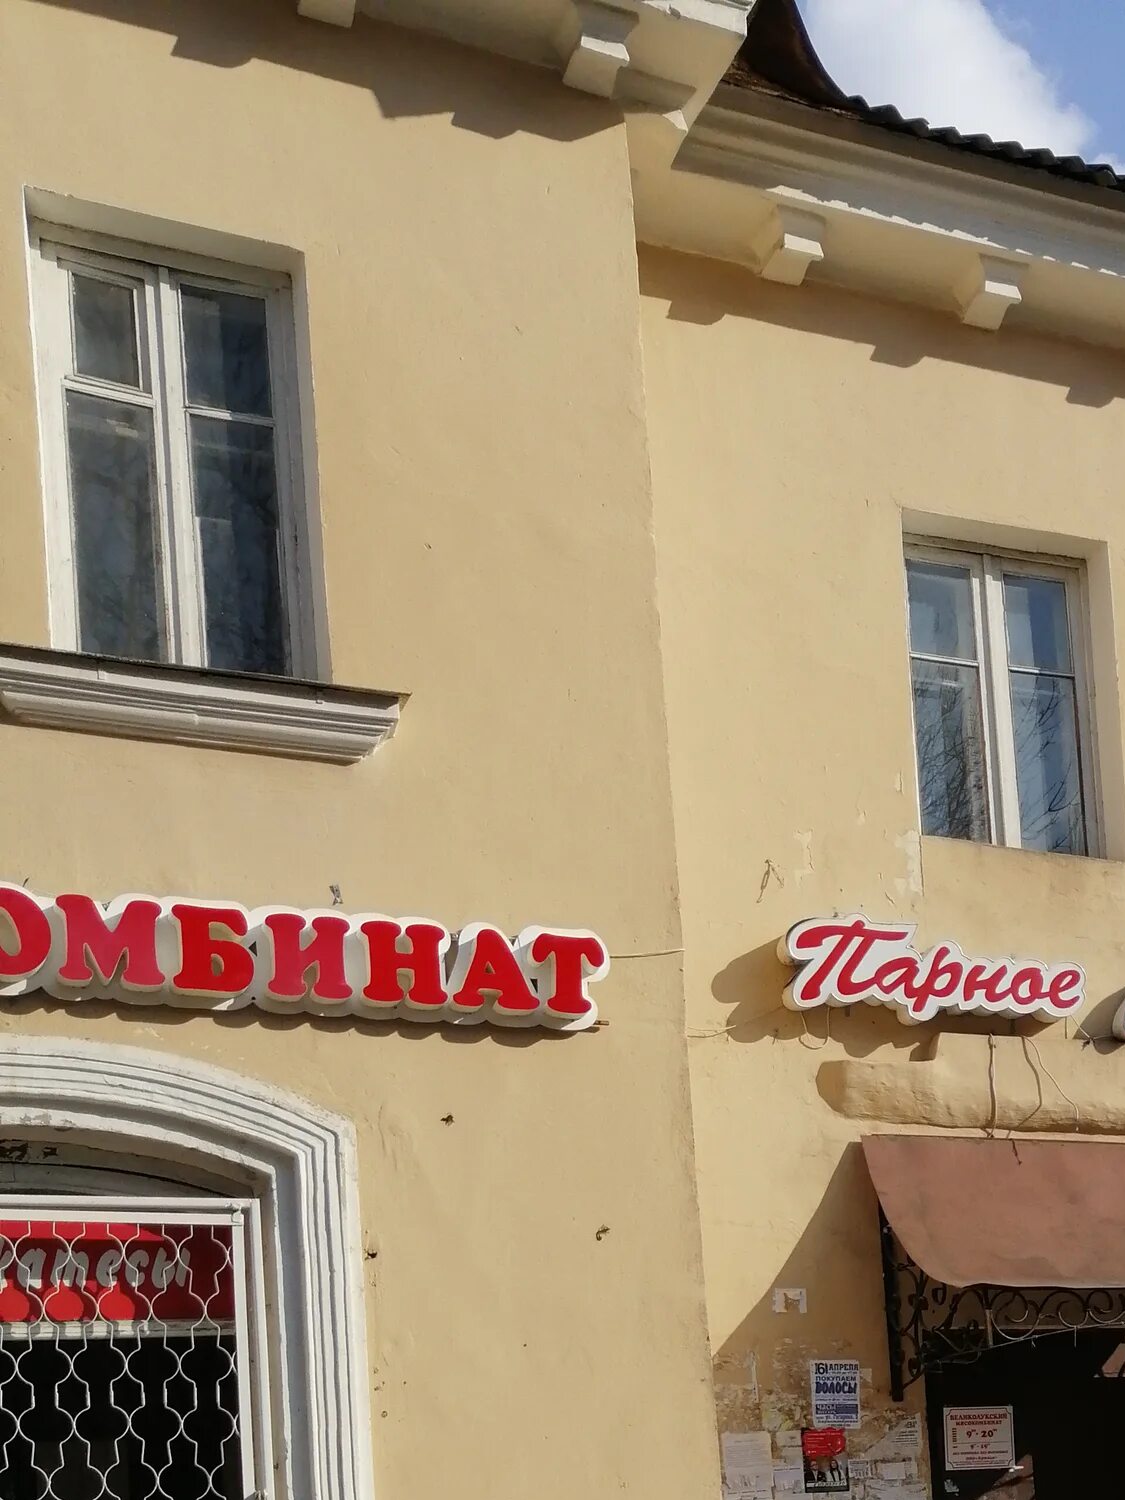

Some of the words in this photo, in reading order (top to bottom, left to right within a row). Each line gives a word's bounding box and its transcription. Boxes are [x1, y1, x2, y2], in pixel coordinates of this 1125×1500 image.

[795, 920, 1082, 1013] Парное
[829, 1363, 859, 1371] АПРЕЛЯ
[815, 1382, 857, 1394] ВОЛОСЫ
